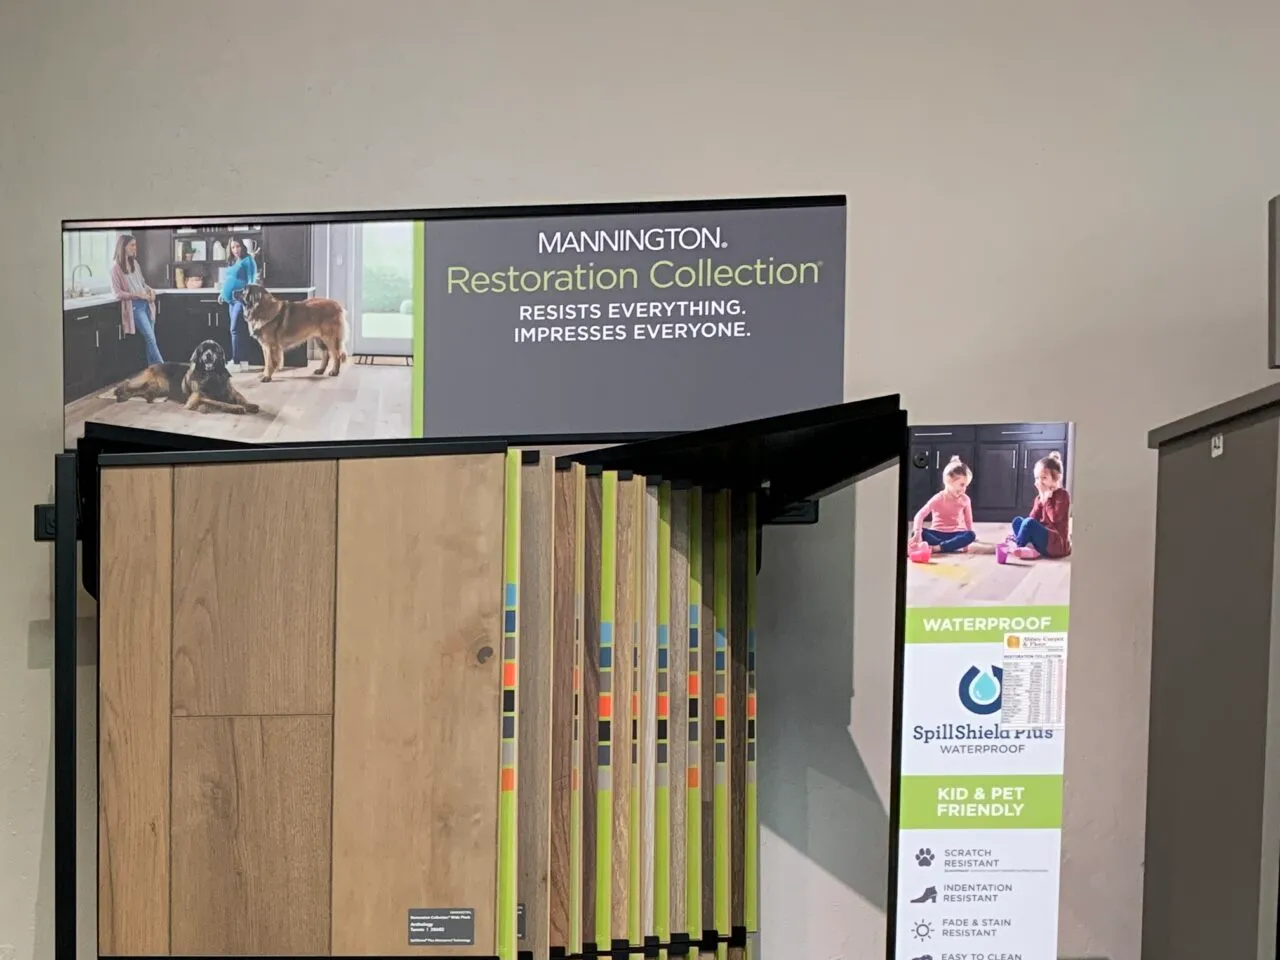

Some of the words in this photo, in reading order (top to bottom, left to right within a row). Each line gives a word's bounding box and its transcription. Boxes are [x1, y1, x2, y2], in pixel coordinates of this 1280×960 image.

[447, 262, 638, 294] Restoration
[520, 303, 601, 321] RESISTS
[609, 299, 746, 318] EVERYTHING.
[514, 325, 627, 343] IMPRESSES
[634, 322, 751, 340] EVERYONE.
[923, 617, 1052, 631] WATERPROOF
[940, 745, 1026, 754] WATERPROOF
[938, 787, 968, 800] KID
[972, 787, 985, 800] &
[991, 787, 1025, 800] PET
[937, 803, 1025, 817] FRIENDLY
[944, 849, 992, 857] SCRATCH
[944, 859, 1000, 868] RESISTANT
[943, 884, 1013, 892] INDENTATION
[943, 894, 998, 902] RESISTANT
[942, 919, 969, 927] FADE
[972, 919, 978, 927] &
[981, 919, 1011, 927] STAIN
[942, 929, 997, 937] RESISTANT
